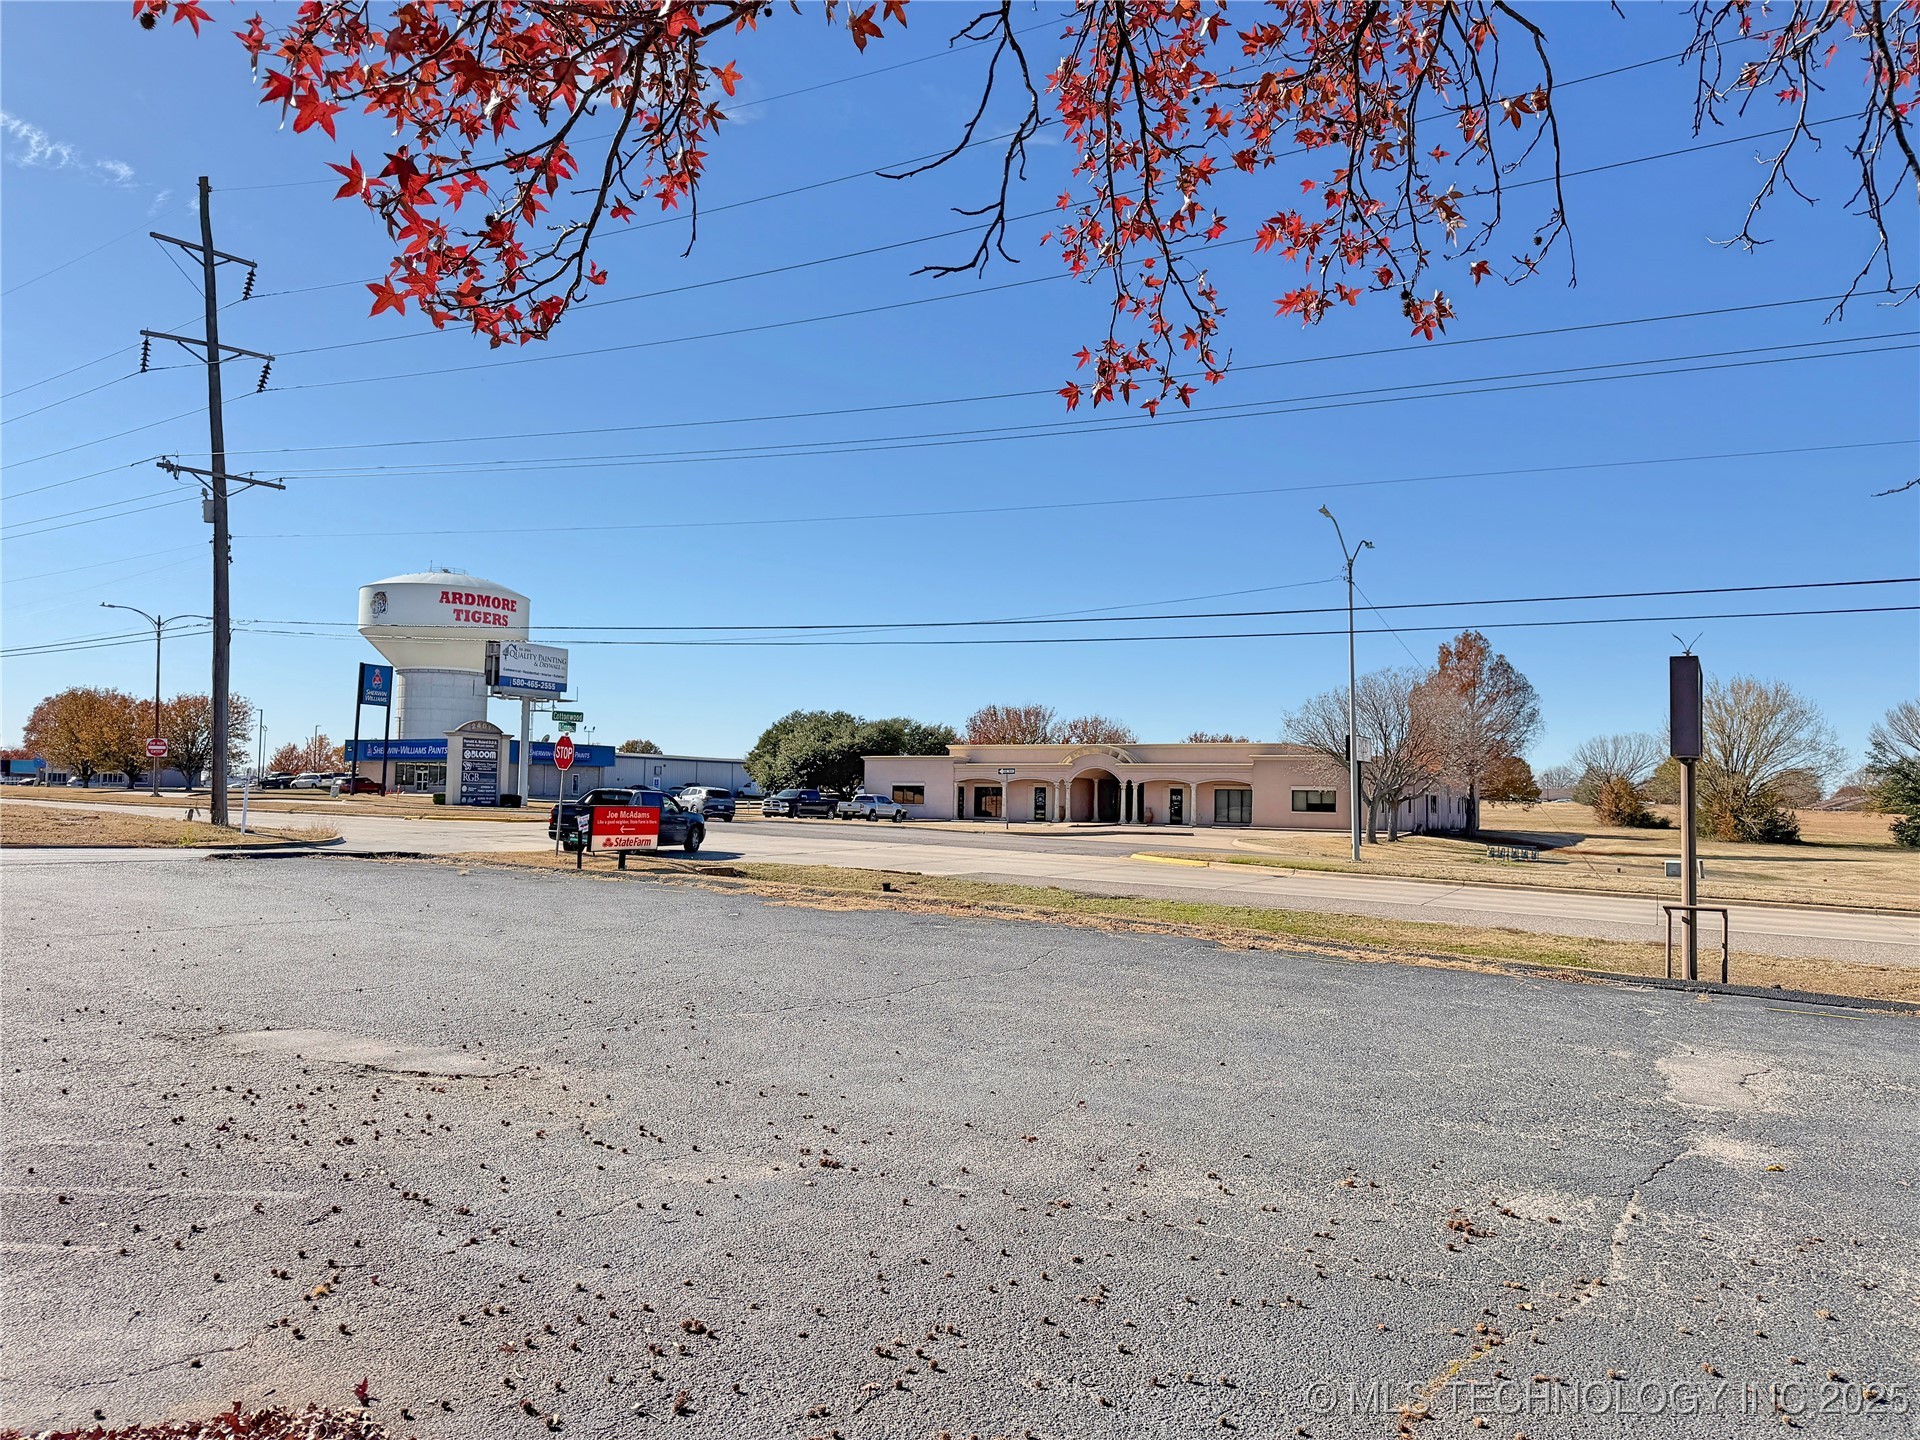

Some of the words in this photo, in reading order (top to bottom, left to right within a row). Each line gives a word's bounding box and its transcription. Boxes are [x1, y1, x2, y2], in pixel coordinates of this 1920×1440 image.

[439, 591, 517, 612] ARDMORE
[453, 609, 508, 626] TIGERS
[510, 650, 537, 660] QUALITY
[538, 654, 567, 665] PAINTING
[512, 678, 556, 690] 580-465-2555
[366, 688, 387, 696] SHERWIN
[373, 745, 427, 755] SHEWIN-WILLIAMS
[427, 745, 447, 755] PAINTS
[471, 751, 497, 759] BLOOM
[556, 746, 573, 760] STOP
[575, 751, 590, 759] PAINTS
[463, 772, 480, 782] RGB
[614, 837, 651, 847] StateFarm
